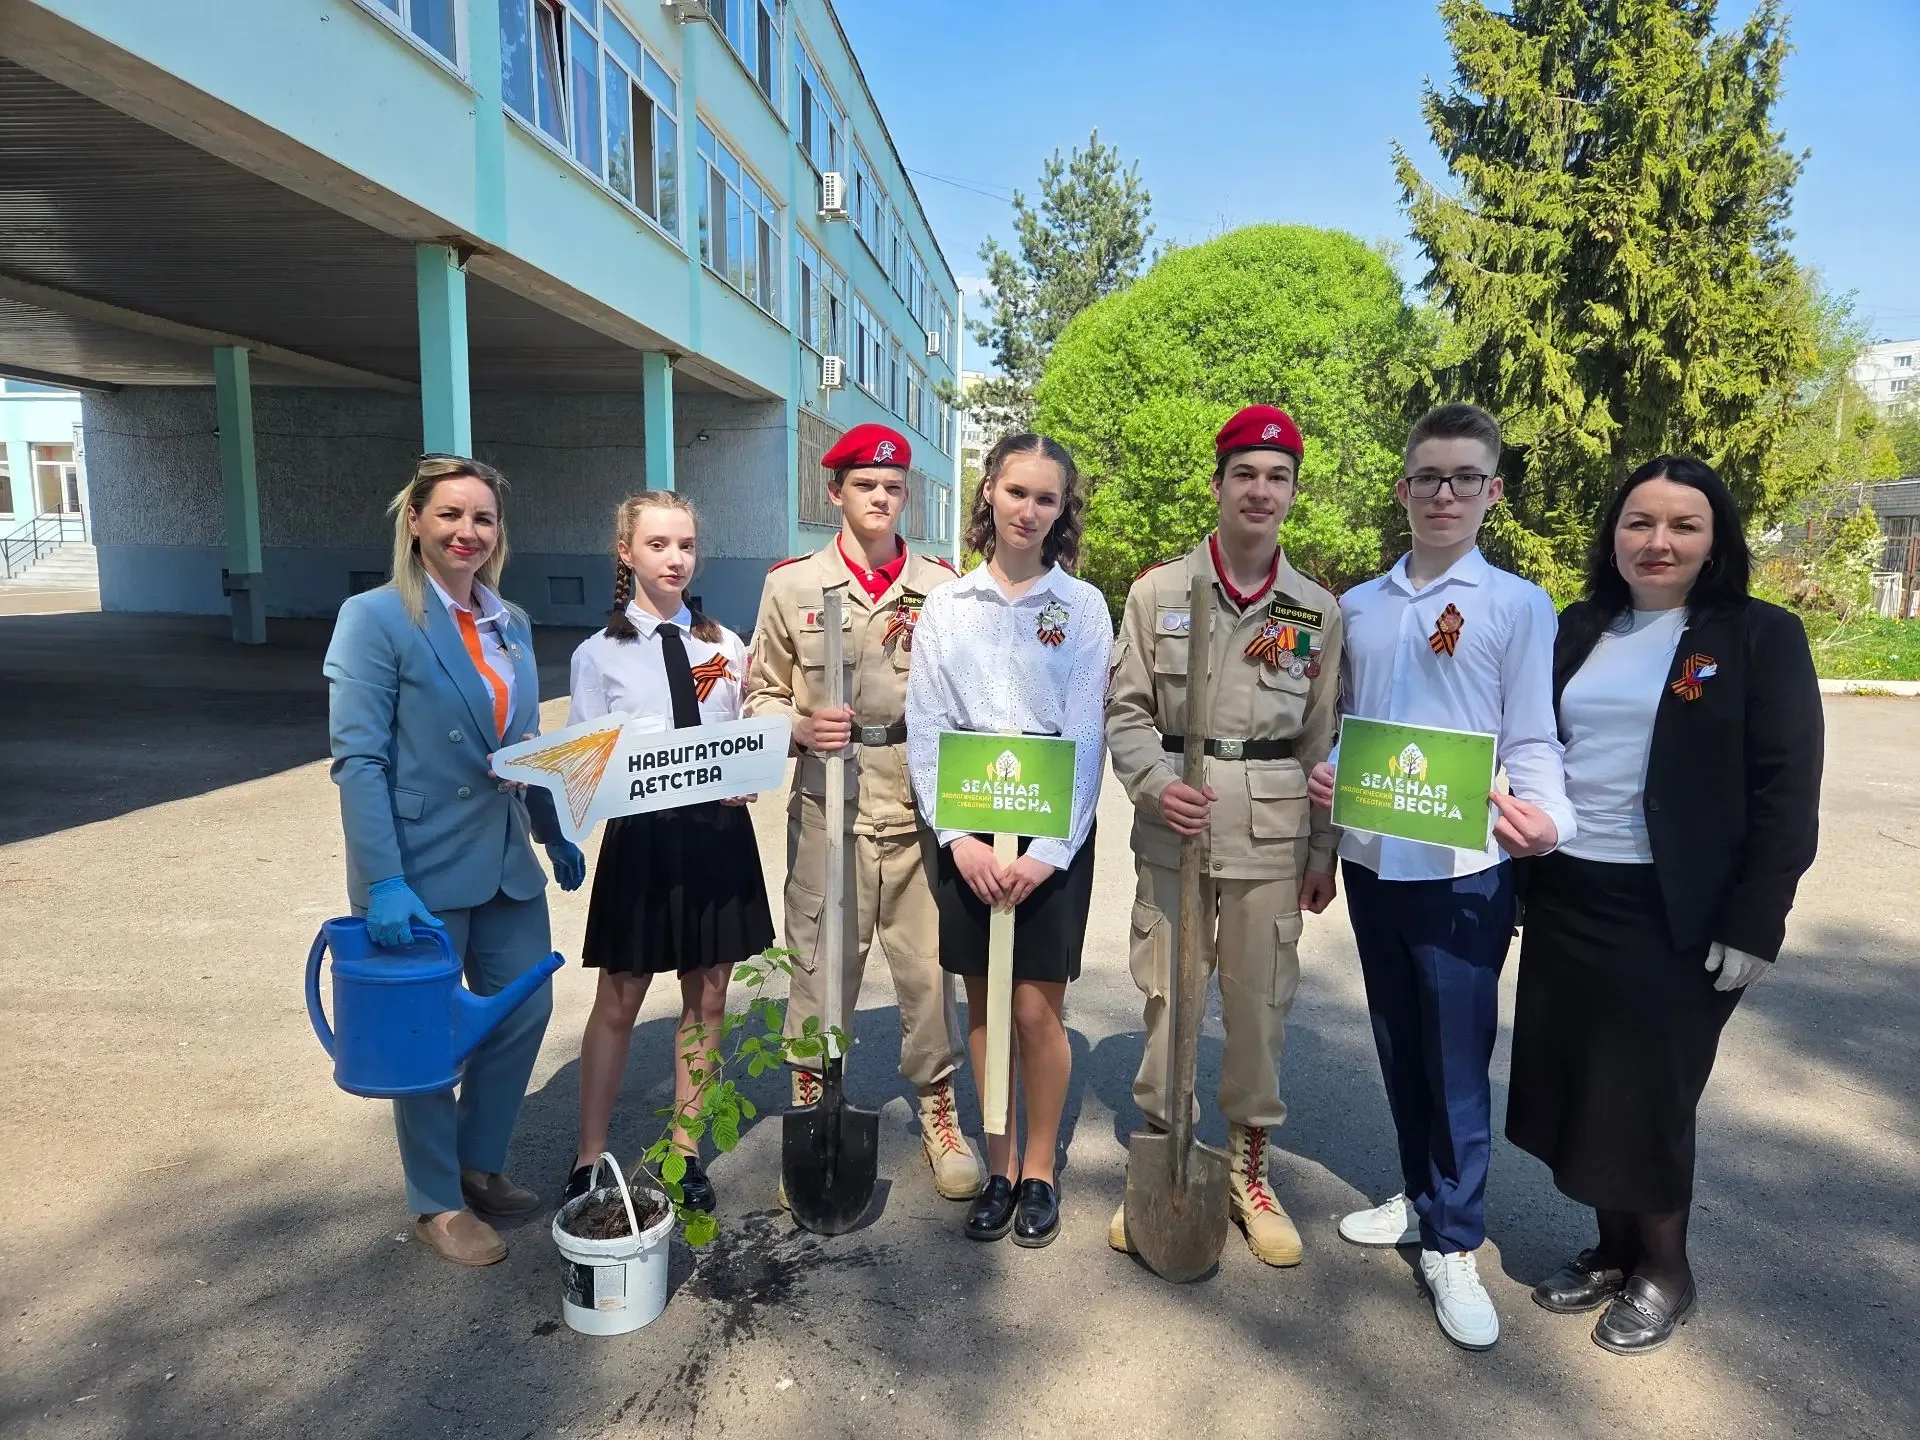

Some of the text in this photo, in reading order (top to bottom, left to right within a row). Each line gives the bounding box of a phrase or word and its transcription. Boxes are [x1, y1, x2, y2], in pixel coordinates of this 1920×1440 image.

[628, 733, 764, 772] НАВИГАТОРЫ
[629, 765, 721, 800] ДЕТСТВА
[962, 779, 1040, 797] ЗЕЛЕНАЯ
[1360, 772, 1448, 800] ЗЕЛЕНАЯ
[942, 792, 992, 801] ЭКОЛОГИЧЕСКИЙ
[1340, 785, 1393, 799] ЭКОЛОГИЧЕСКИЙ
[957, 801, 992, 809] СУББОТНИК
[993, 797, 1052, 813] ВЕСНА
[1355, 796, 1392, 809] СУББОТНИК
[1394, 795, 1463, 820] ВЕСНА
